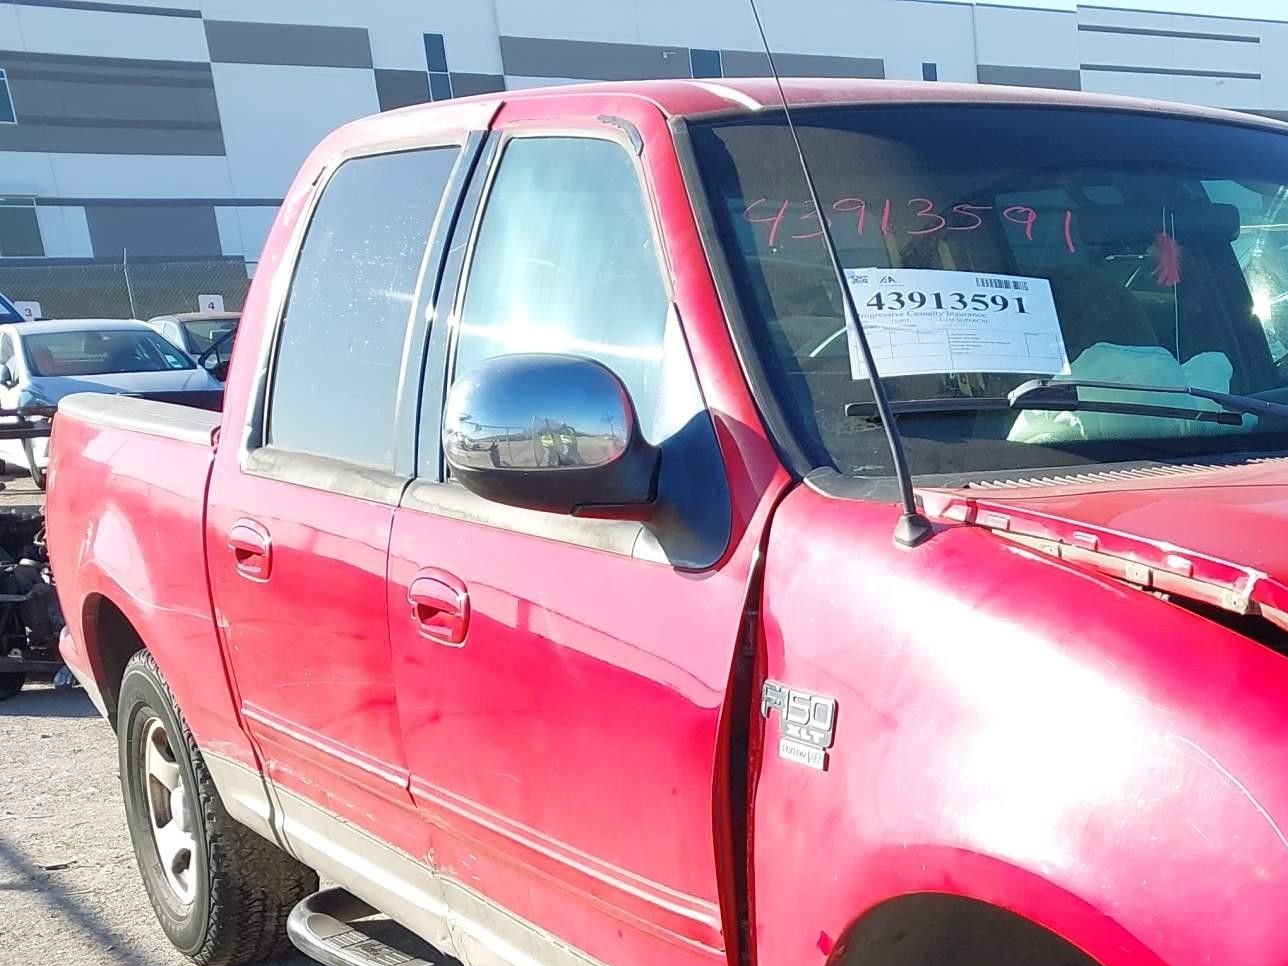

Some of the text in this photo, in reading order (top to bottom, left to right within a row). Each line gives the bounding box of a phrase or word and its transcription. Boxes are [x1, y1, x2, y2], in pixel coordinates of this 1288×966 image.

[743, 198, 1076, 253] 43913591
[207, 301, 215, 310] 4
[866, 291, 1029, 314] 43913591
[24, 308, 33, 317] 3
[858, 310, 987, 319] rogressive Casualty Insurance
[784, 723, 827, 744] XLT
